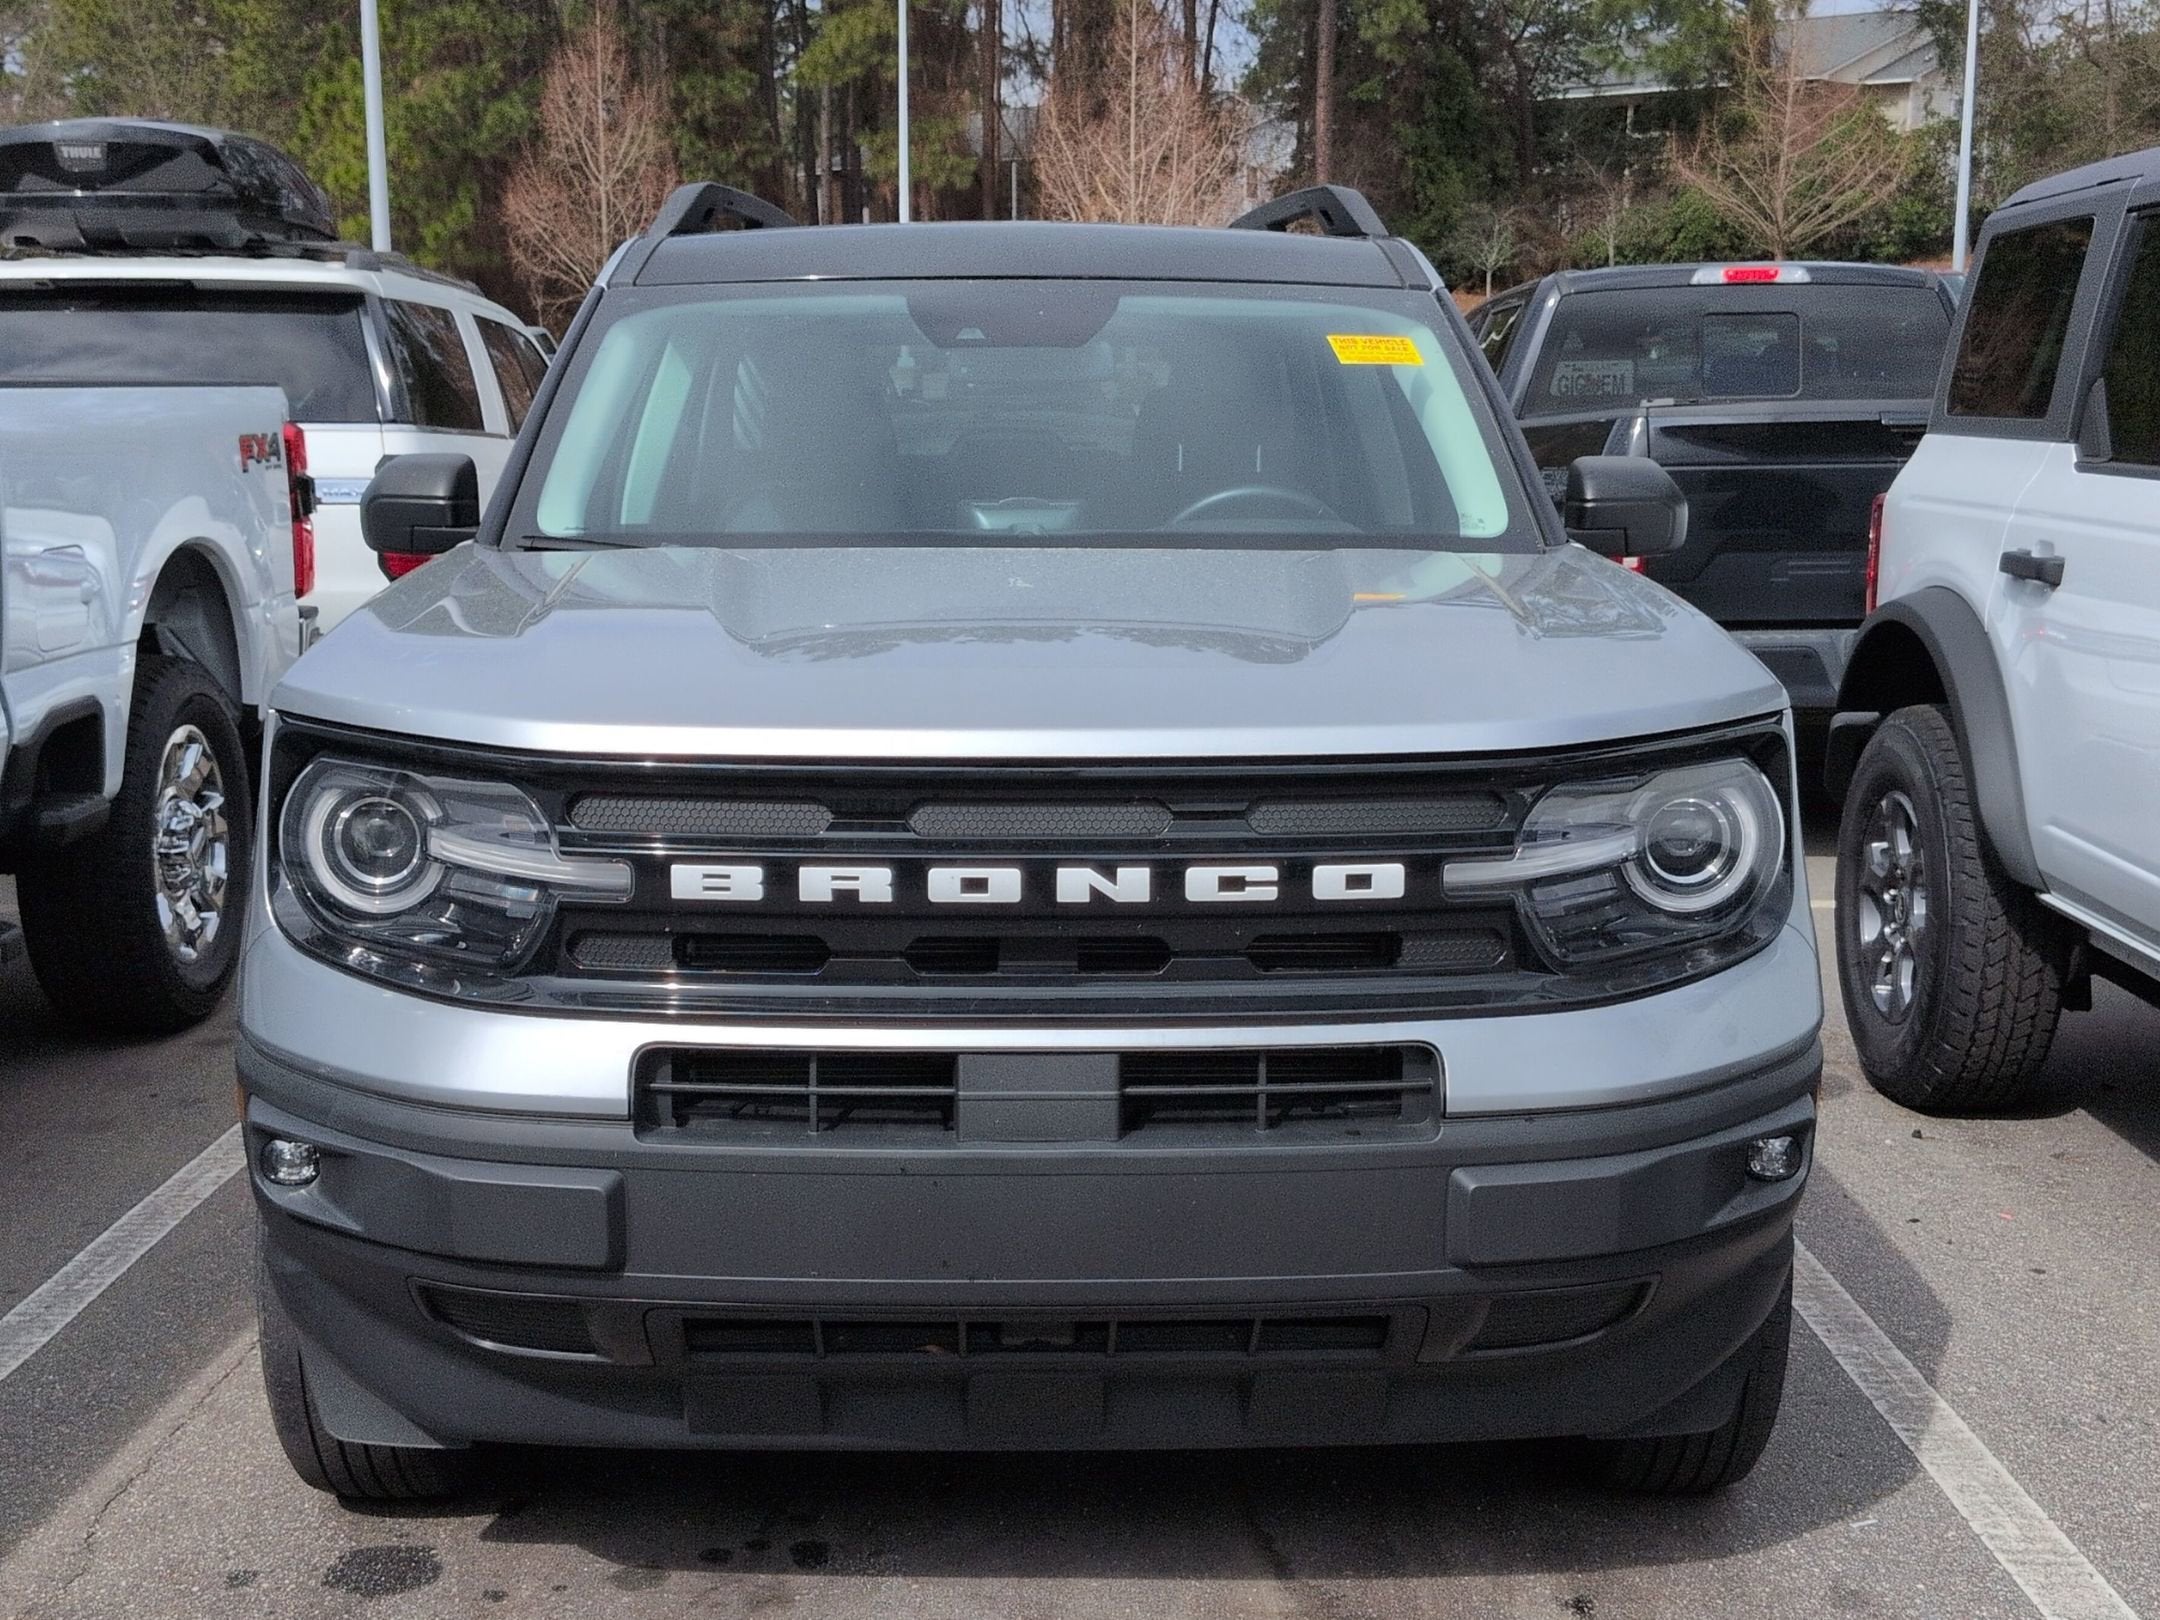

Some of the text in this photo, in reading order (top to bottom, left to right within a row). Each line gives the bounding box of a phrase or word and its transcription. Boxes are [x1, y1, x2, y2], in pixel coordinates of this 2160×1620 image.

[61, 145, 102, 159] THULE
[1332, 337, 1409, 346] THIS VEHICLE
[238, 432, 282, 473] FX4
[670, 863, 1405, 903] BRONCO
